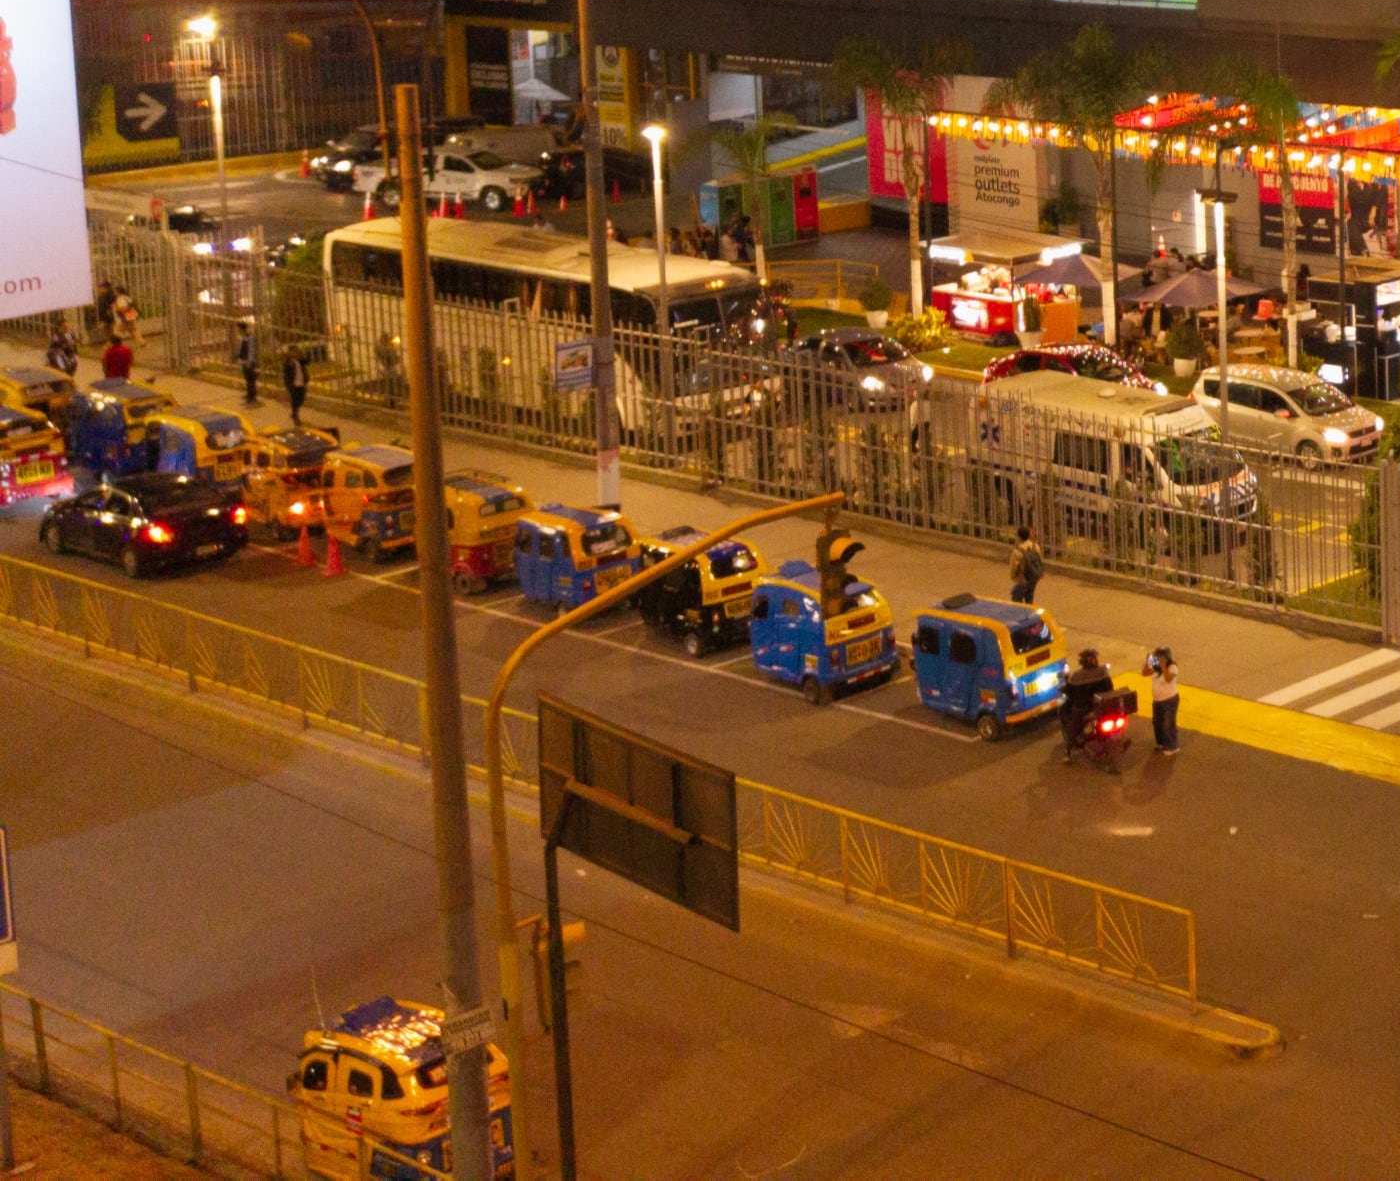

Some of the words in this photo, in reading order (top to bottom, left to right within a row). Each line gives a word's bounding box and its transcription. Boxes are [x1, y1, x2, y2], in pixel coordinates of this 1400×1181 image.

[975, 164, 1019, 178] premium
[975, 177, 1019, 194] outlets
[1276, 175, 1328, 192] DCUENTO
[976, 190, 1020, 207] Atocongo
[0, 276, 42, 295] om
